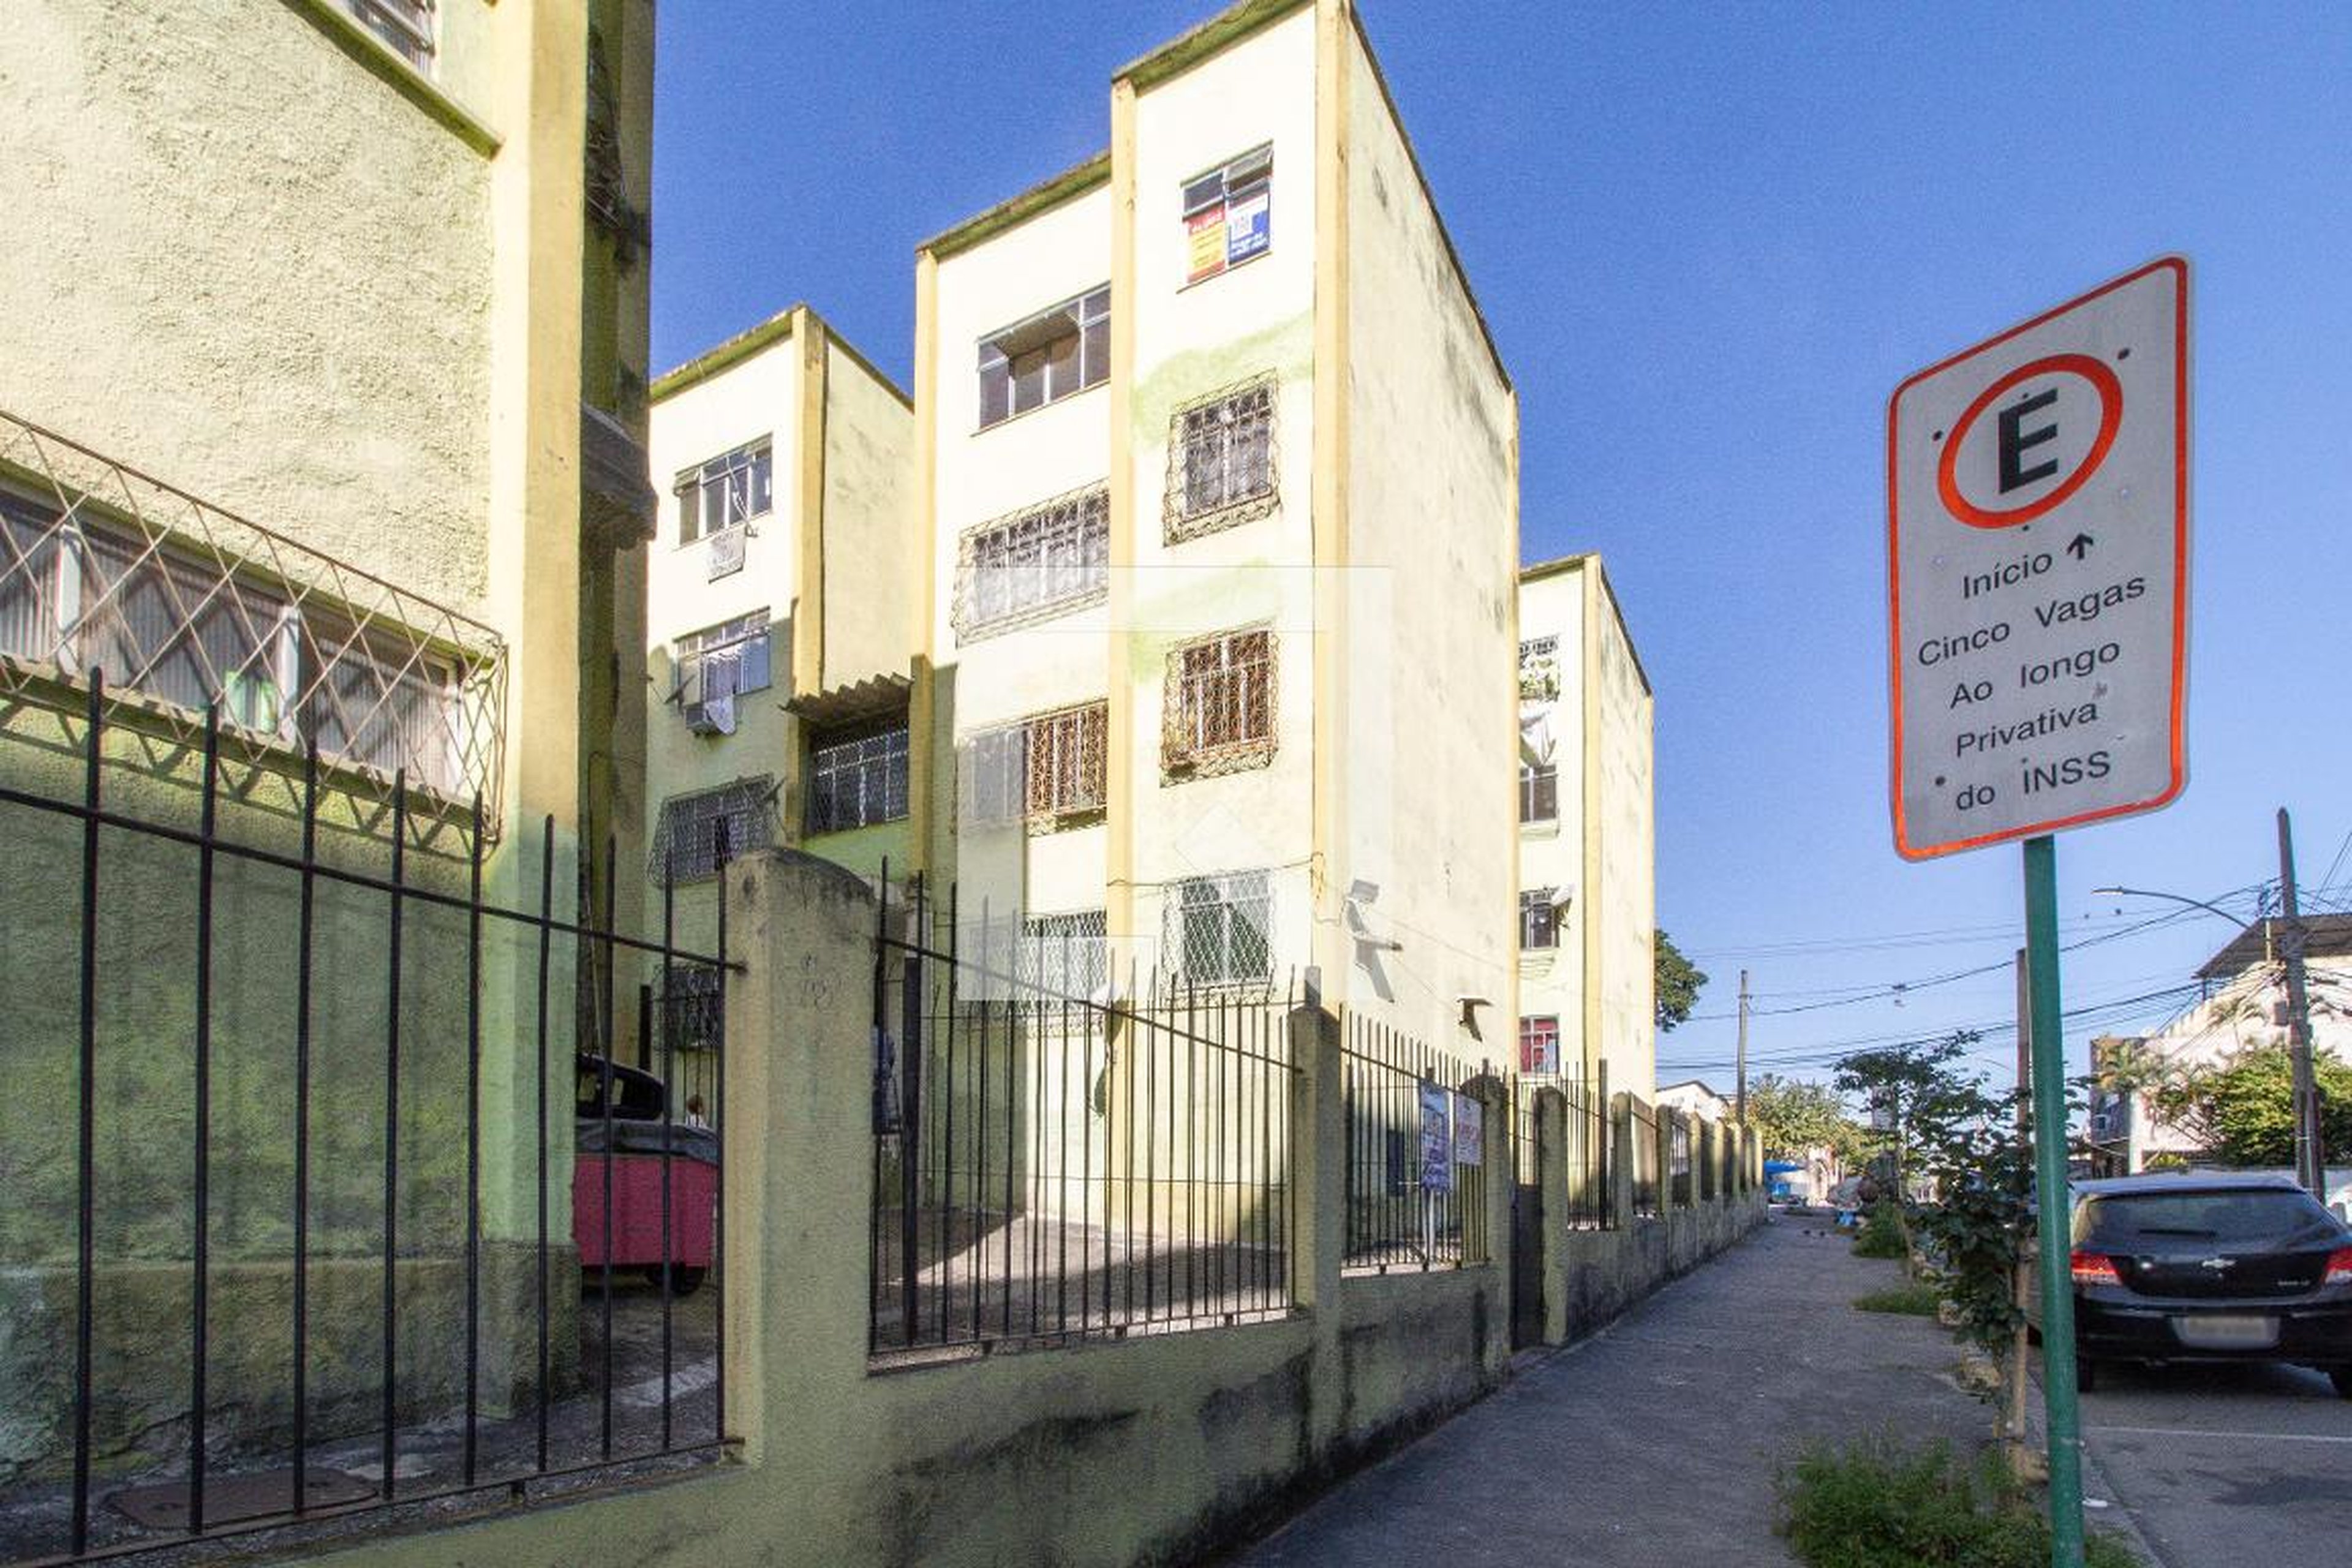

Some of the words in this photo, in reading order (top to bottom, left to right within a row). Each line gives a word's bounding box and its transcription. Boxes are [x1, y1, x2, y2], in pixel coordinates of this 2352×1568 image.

[1997, 389, 2058, 494] E
[1962, 552, 2053, 599] Início
[1918, 622, 2011, 666] Cinco
[2034, 576, 2146, 628] Vagas
[1949, 680, 1994, 710] Ao
[2021, 642, 2120, 688] longo
[1956, 703, 2098, 758] Privativa
[1956, 784, 1996, 811] do
[2022, 751, 2111, 795] INSS
